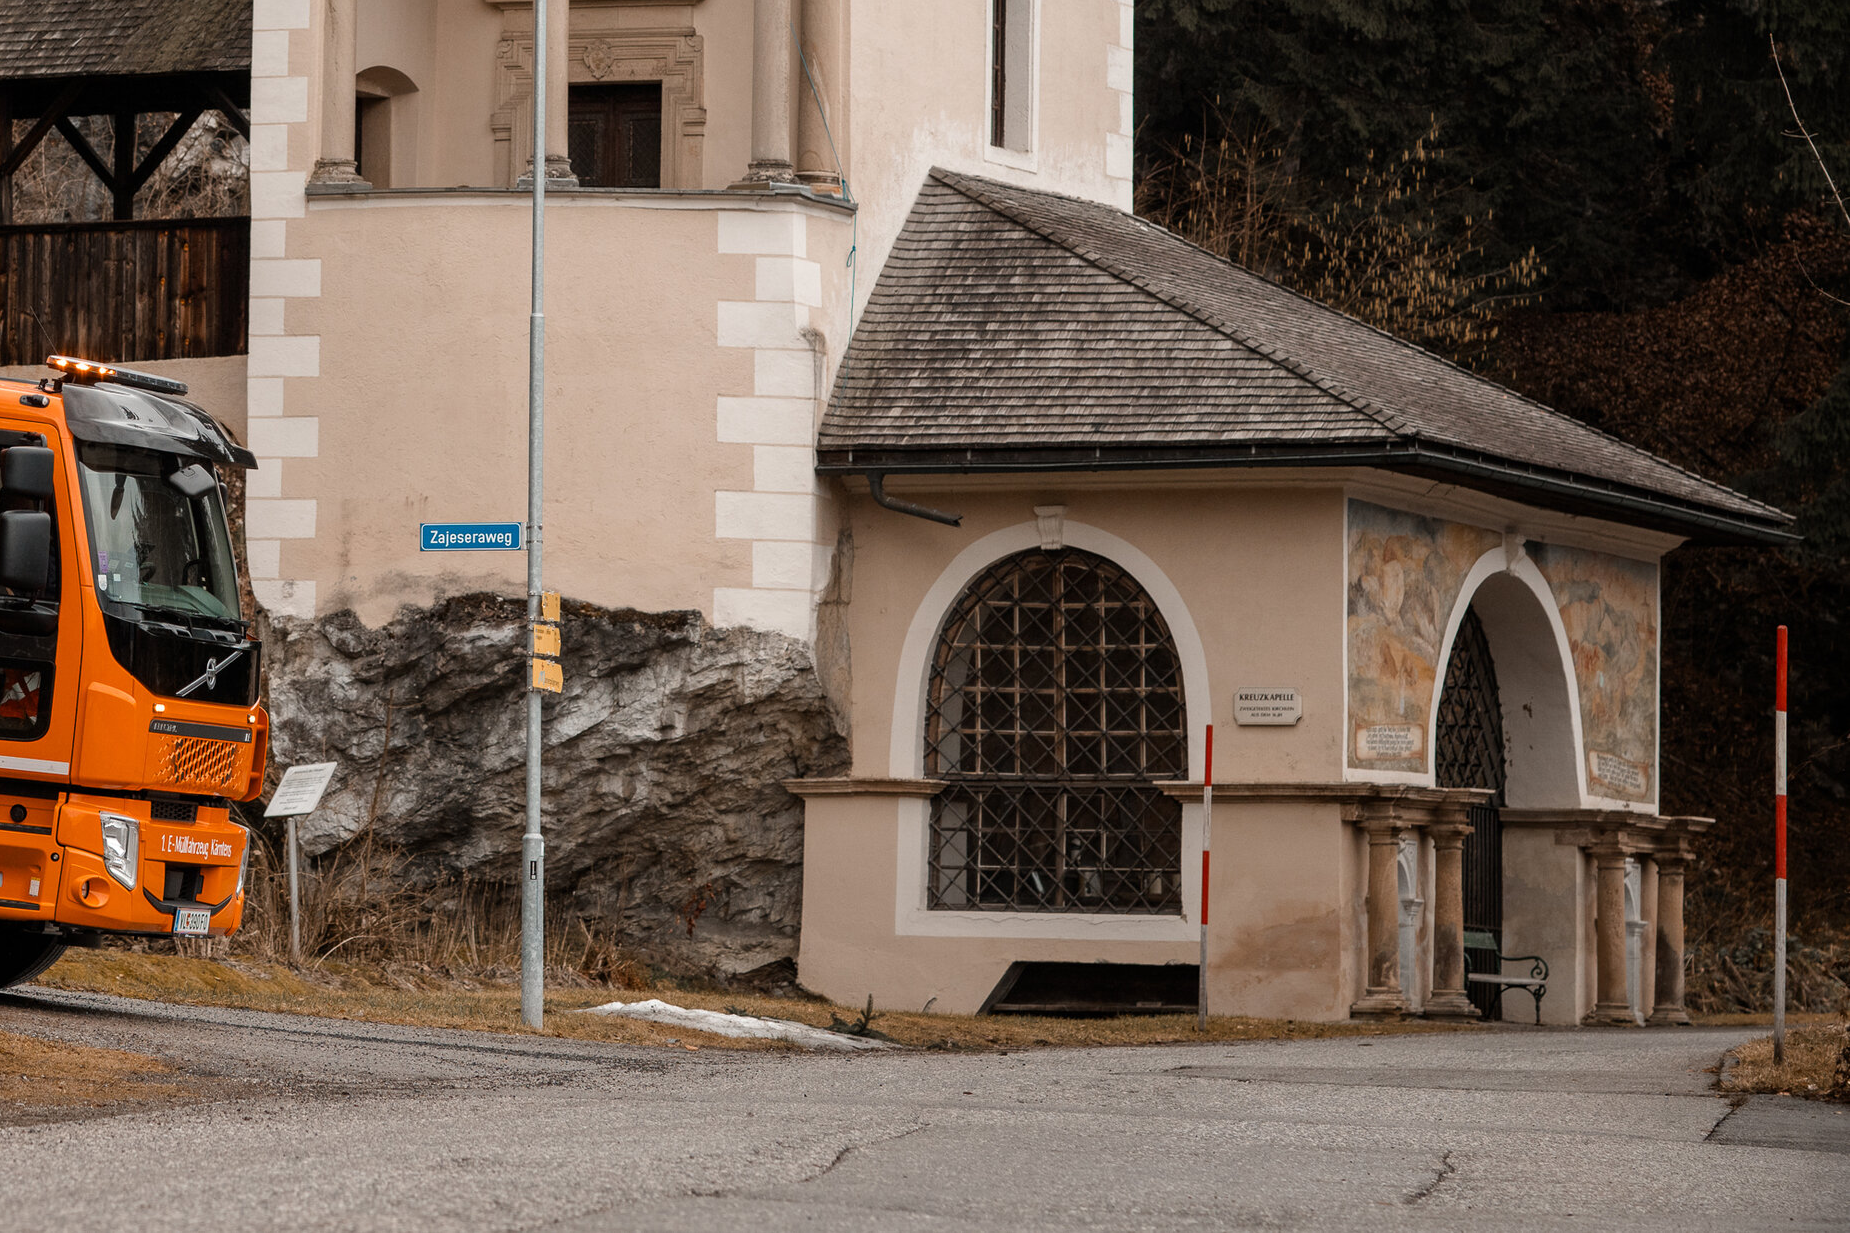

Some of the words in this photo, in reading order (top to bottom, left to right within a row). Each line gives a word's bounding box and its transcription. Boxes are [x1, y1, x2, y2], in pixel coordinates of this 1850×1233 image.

[430, 530, 512, 547] Zajeseraweg
[1239, 693, 1294, 701] KREUZKAPELLE
[167, 834, 209, 860] E-Müllfahrzeug
[210, 838, 232, 858] Kärntens
